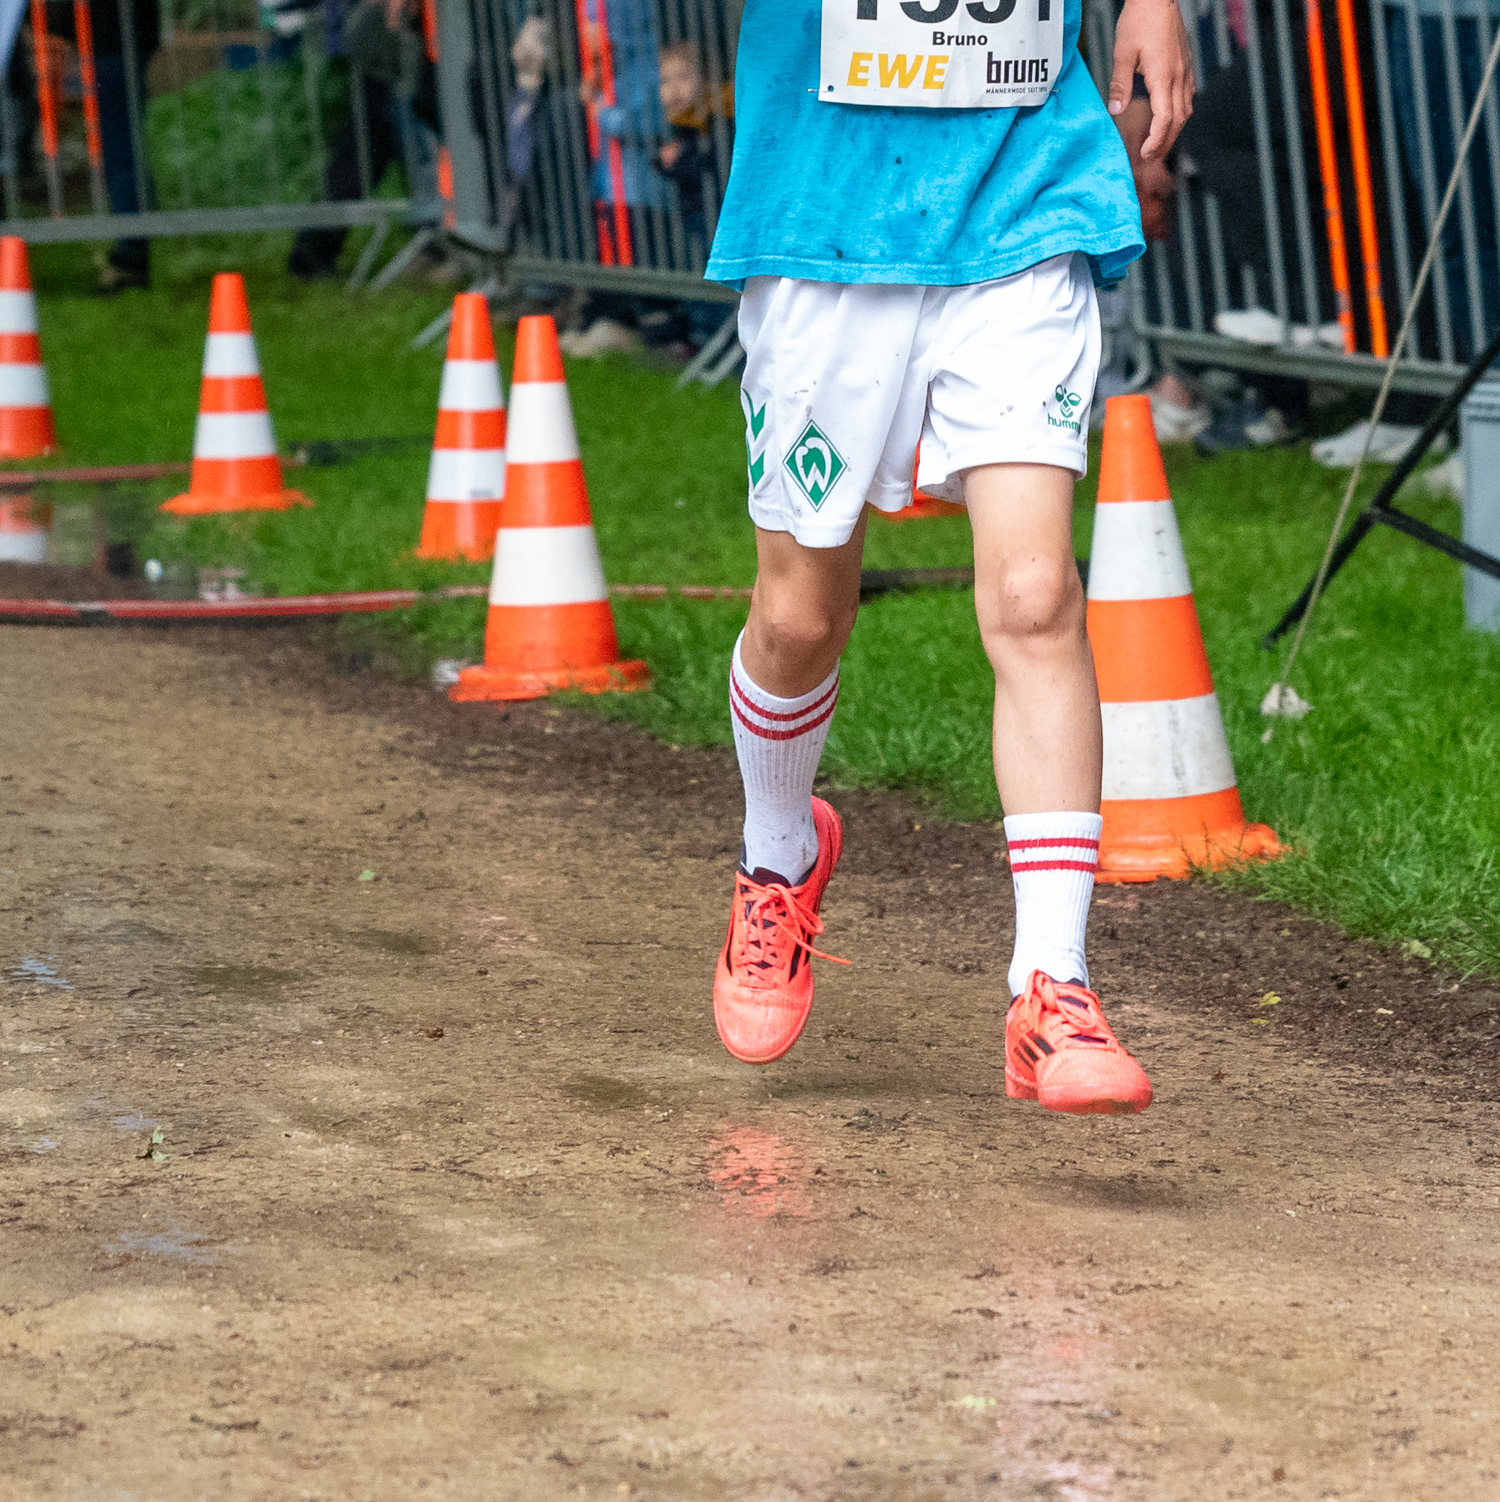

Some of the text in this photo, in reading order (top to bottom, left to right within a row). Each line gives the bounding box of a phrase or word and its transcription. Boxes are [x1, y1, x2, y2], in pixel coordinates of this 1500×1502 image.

[932, 31, 988, 46] Bruno
[847, 51, 949, 90] EWE
[986, 51, 1049, 84] bruns
[1047, 412, 1081, 435] humm
